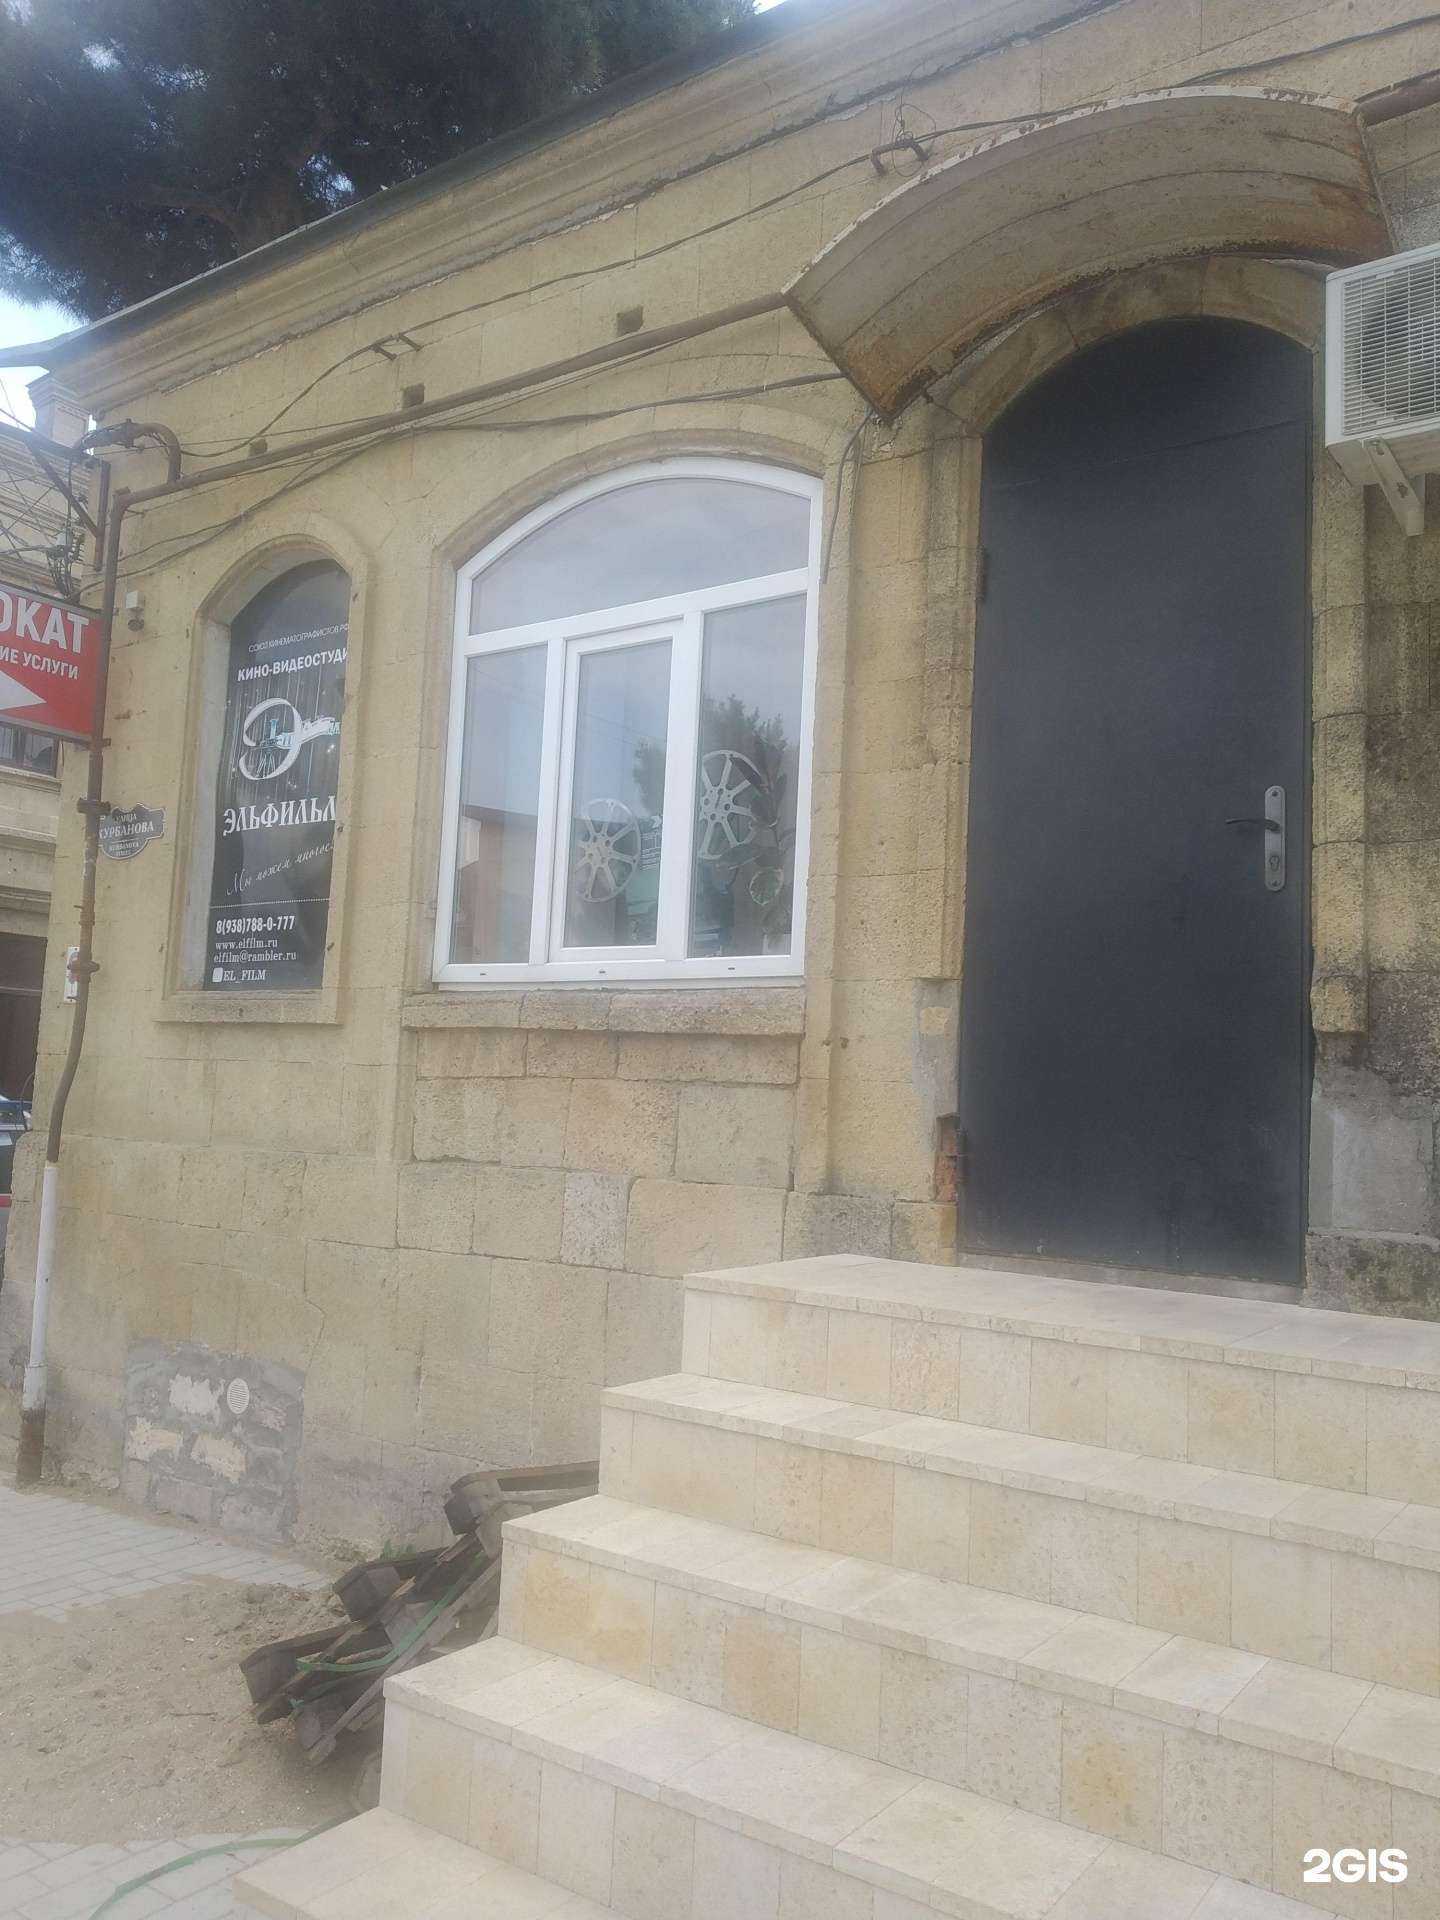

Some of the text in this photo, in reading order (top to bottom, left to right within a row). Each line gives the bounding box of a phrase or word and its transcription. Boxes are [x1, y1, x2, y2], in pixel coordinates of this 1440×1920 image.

[23, 651, 79, 679] УСЛУГИ
[216, 915, 295, 935] 8(938)788-0-777
[215, 937, 278, 950] www.elfilm.ru
[213, 950, 297, 963] elfilm@rambler.ru
[223, 969, 266, 983] EL_FILM
